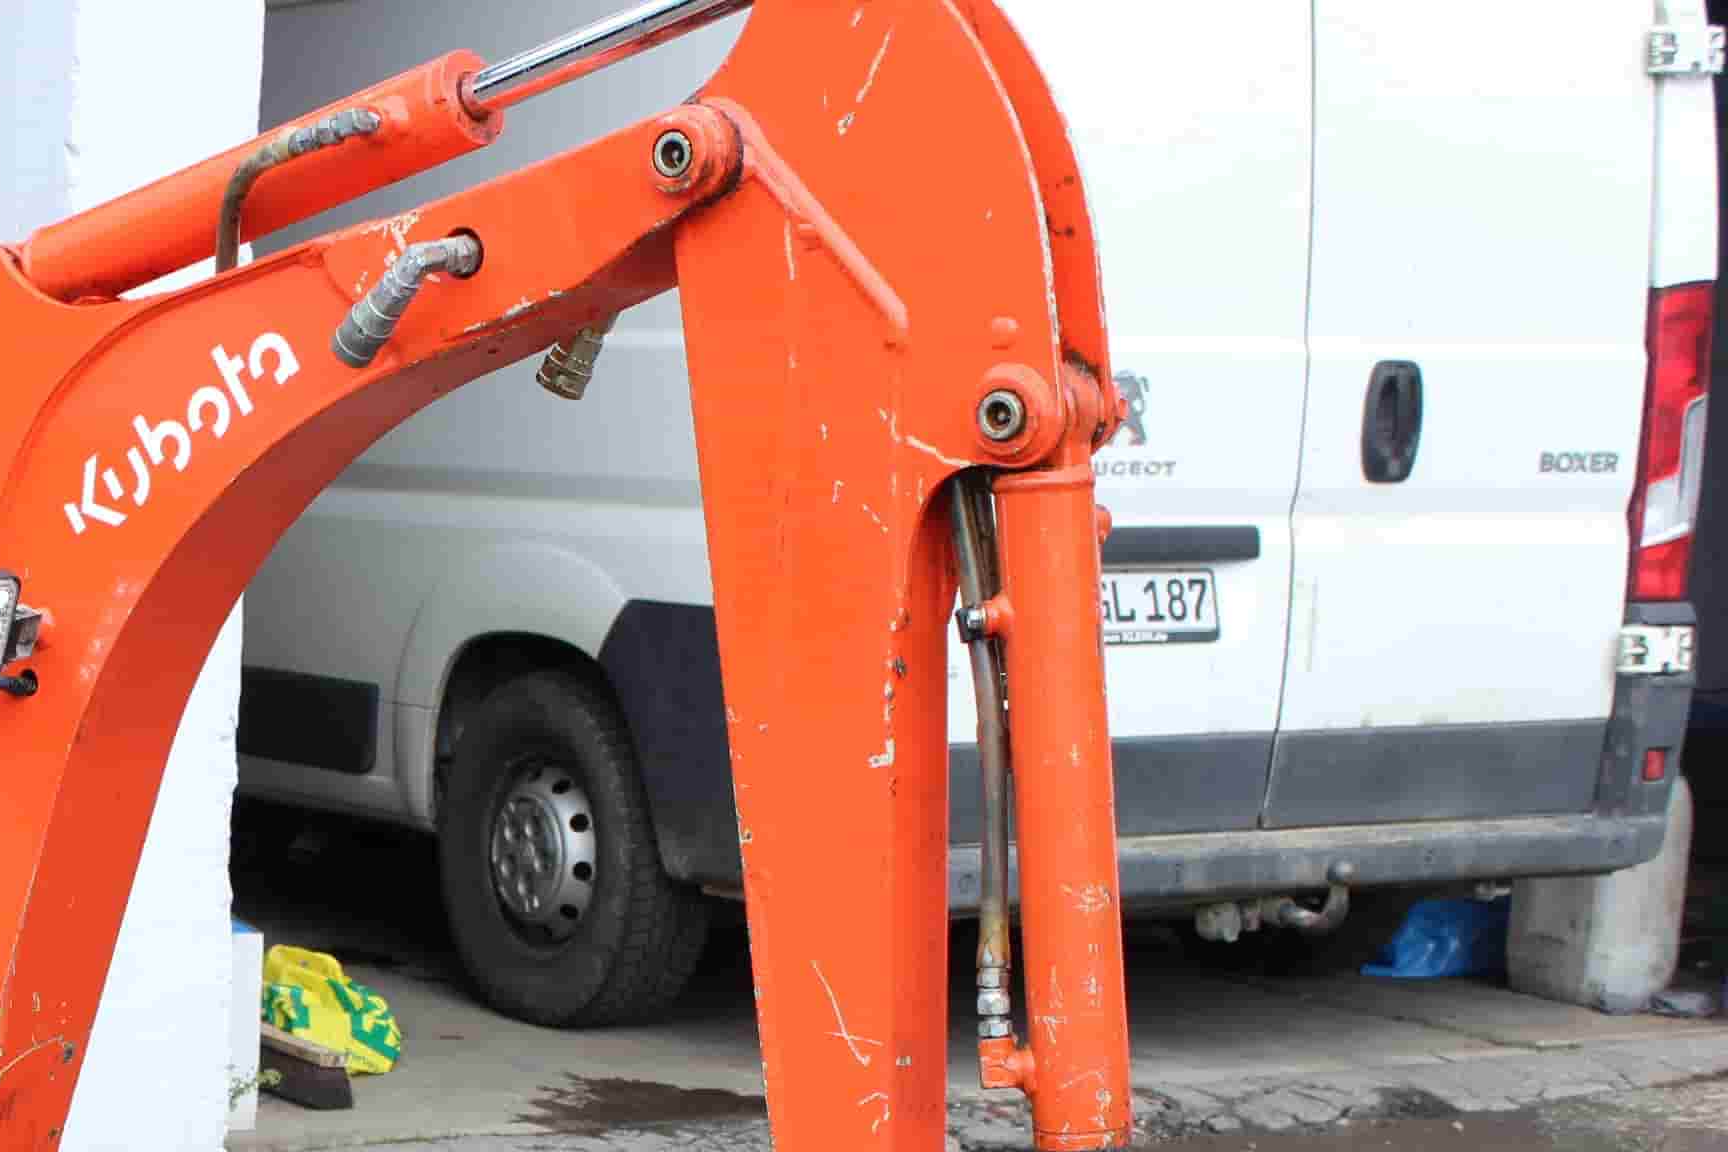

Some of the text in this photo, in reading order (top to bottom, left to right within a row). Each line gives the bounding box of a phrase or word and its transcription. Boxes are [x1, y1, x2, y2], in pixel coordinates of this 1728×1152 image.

[64, 332, 300, 534] Kubota
[1094, 460, 1177, 477] UGEOT
[1539, 451, 1619, 473] BOXER
[1143, 578, 1207, 622] 187
